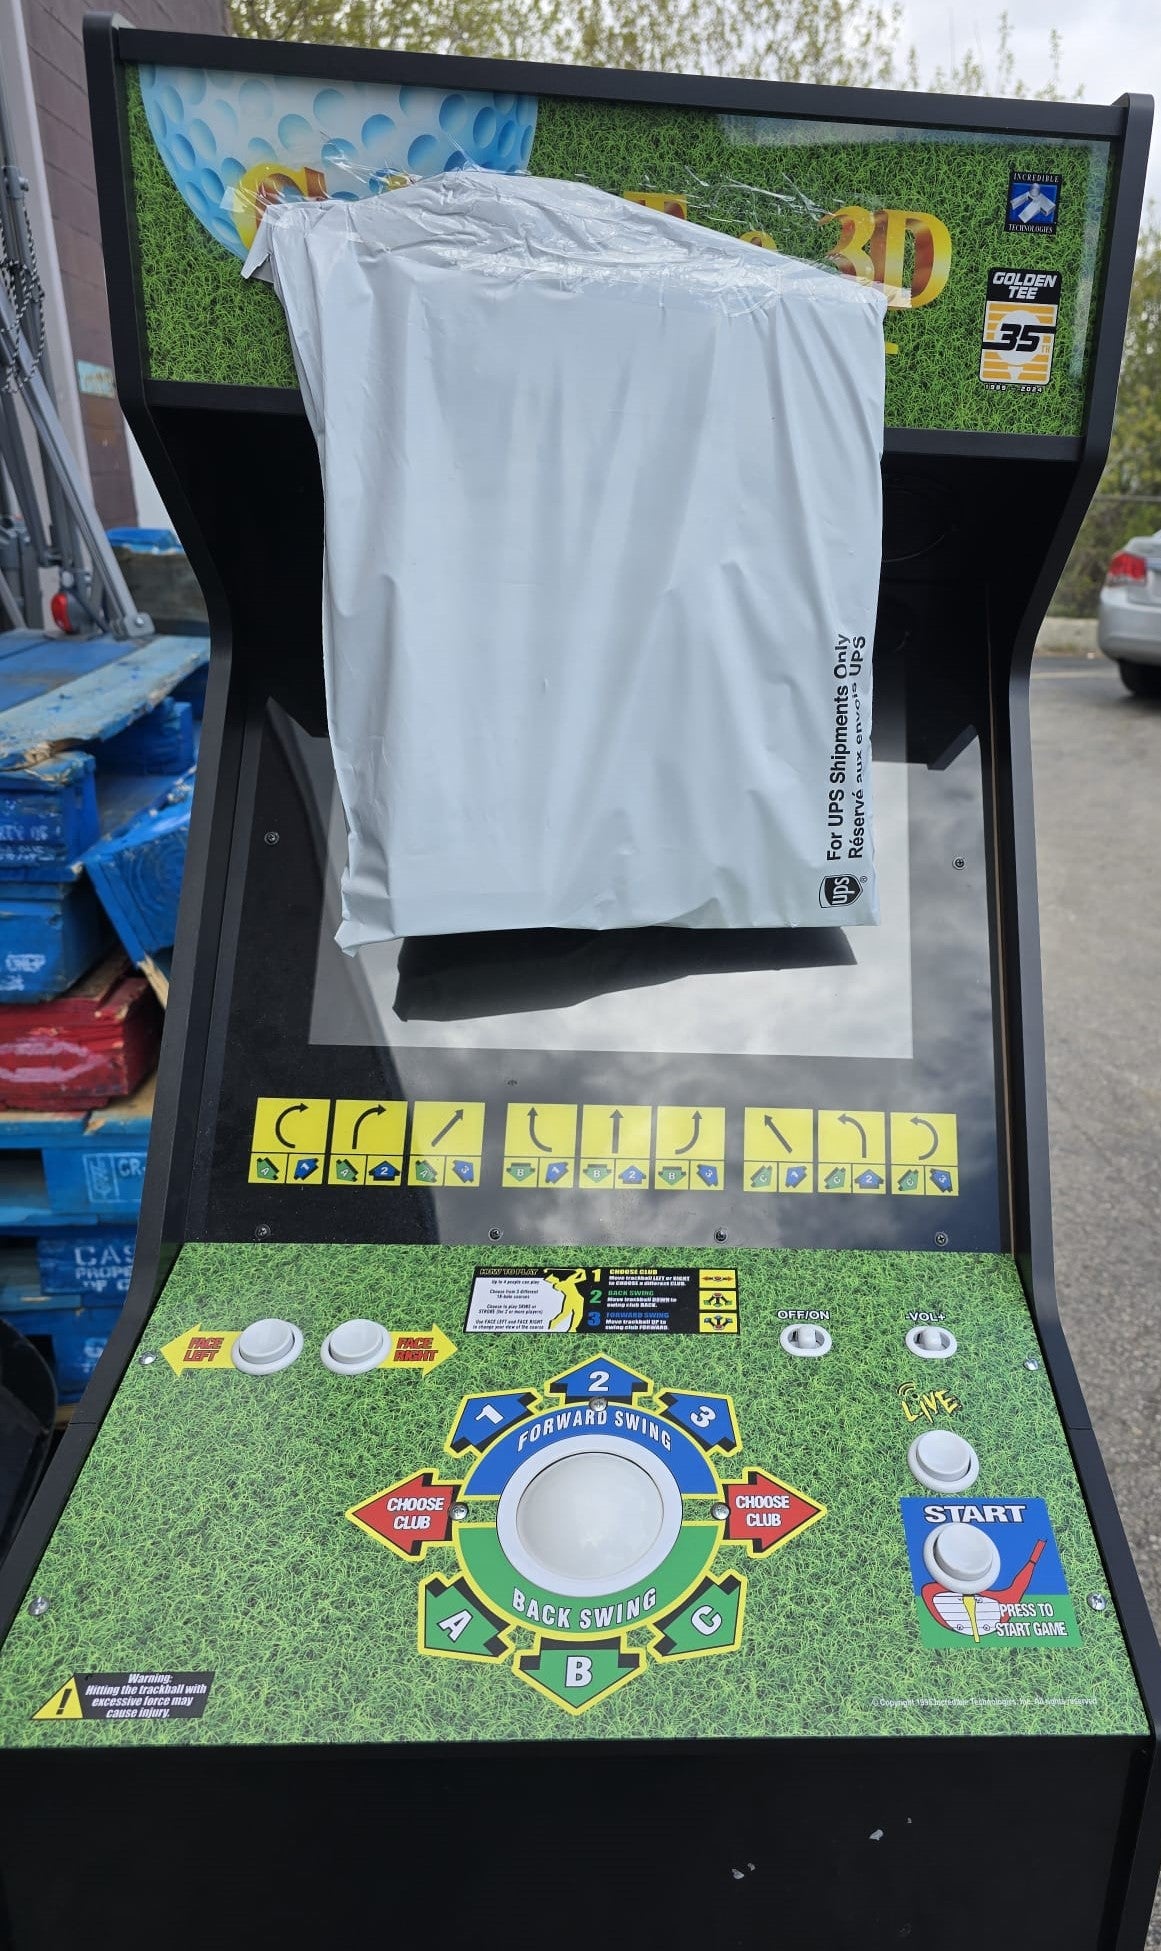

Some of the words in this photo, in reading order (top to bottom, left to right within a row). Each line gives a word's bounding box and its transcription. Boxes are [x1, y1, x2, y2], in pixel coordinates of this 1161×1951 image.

[1012, 172, 1059, 184] INCREDIBLE
[1007, 222, 1054, 234] TECHNOLOGIES
[992, 271, 1058, 288] GOLDEN
[1008, 285, 1038, 300] TEE
[990, 323, 1053, 352] 35
[1020, 385, 1043, 394] 2024
[834, 633, 851, 679] Only
[848, 635, 866, 677] UPS
[830, 684, 850, 784] Shipments
[856, 749, 864, 784] aux
[827, 788, 845, 827] UPS
[848, 790, 865, 860] Réservé
[826, 831, 843, 861] For
[831, 875, 851, 906] ups
[117, 1157, 146, 1177] CR
[592, 1268, 601, 1283] 1
[590, 1289, 603, 1304] 2
[587, 1311, 601, 1326] 3
[777, 1310, 830, 1320] OFF/ON
[188, 1337, 224, 1350] FACE
[396, 1337, 434, 1350] FACE
[183, 1349, 219, 1362] LEFT
[393, 1349, 439, 1362] RIGHT
[588, 1370, 610, 1392] 2
[475, 1404, 504, 1425] 1
[690, 1405, 717, 1428] 3
[517, 1410, 608, 1452] FORWARD
[614, 1410, 672, 1452] SWING
[386, 1497, 445, 1512] CHOOSE
[735, 1495, 790, 1509] CHOOSE
[746, 1513, 782, 1527] CLUB
[924, 1504, 1026, 1523] START
[393, 1515, 431, 1530] CLUB
[511, 1587, 571, 1629] BACK
[578, 1587, 657, 1630] SWING
[1000, 1603, 1037, 1617] PRESS
[1038, 1603, 1054, 1617] TO
[436, 1609, 473, 1642] A
[691, 1604, 723, 1637] C
[995, 1621, 1032, 1636] START
[1033, 1621, 1068, 1636] GAME
[127, 1673, 174, 1684] Warning:
[565, 1655, 593, 1687] B
[85, 1685, 120, 1696] Hitting
[120, 1684, 137, 1695] the
[138, 1684, 184, 1695] trackball
[185, 1684, 208, 1694] with
[91, 1697, 142, 1707] excessive
[143, 1696, 171, 1706] force
[171, 1697, 194, 1706] may
[105, 1708, 137, 1718] cause
[138, 1707, 170, 1719] injury.
